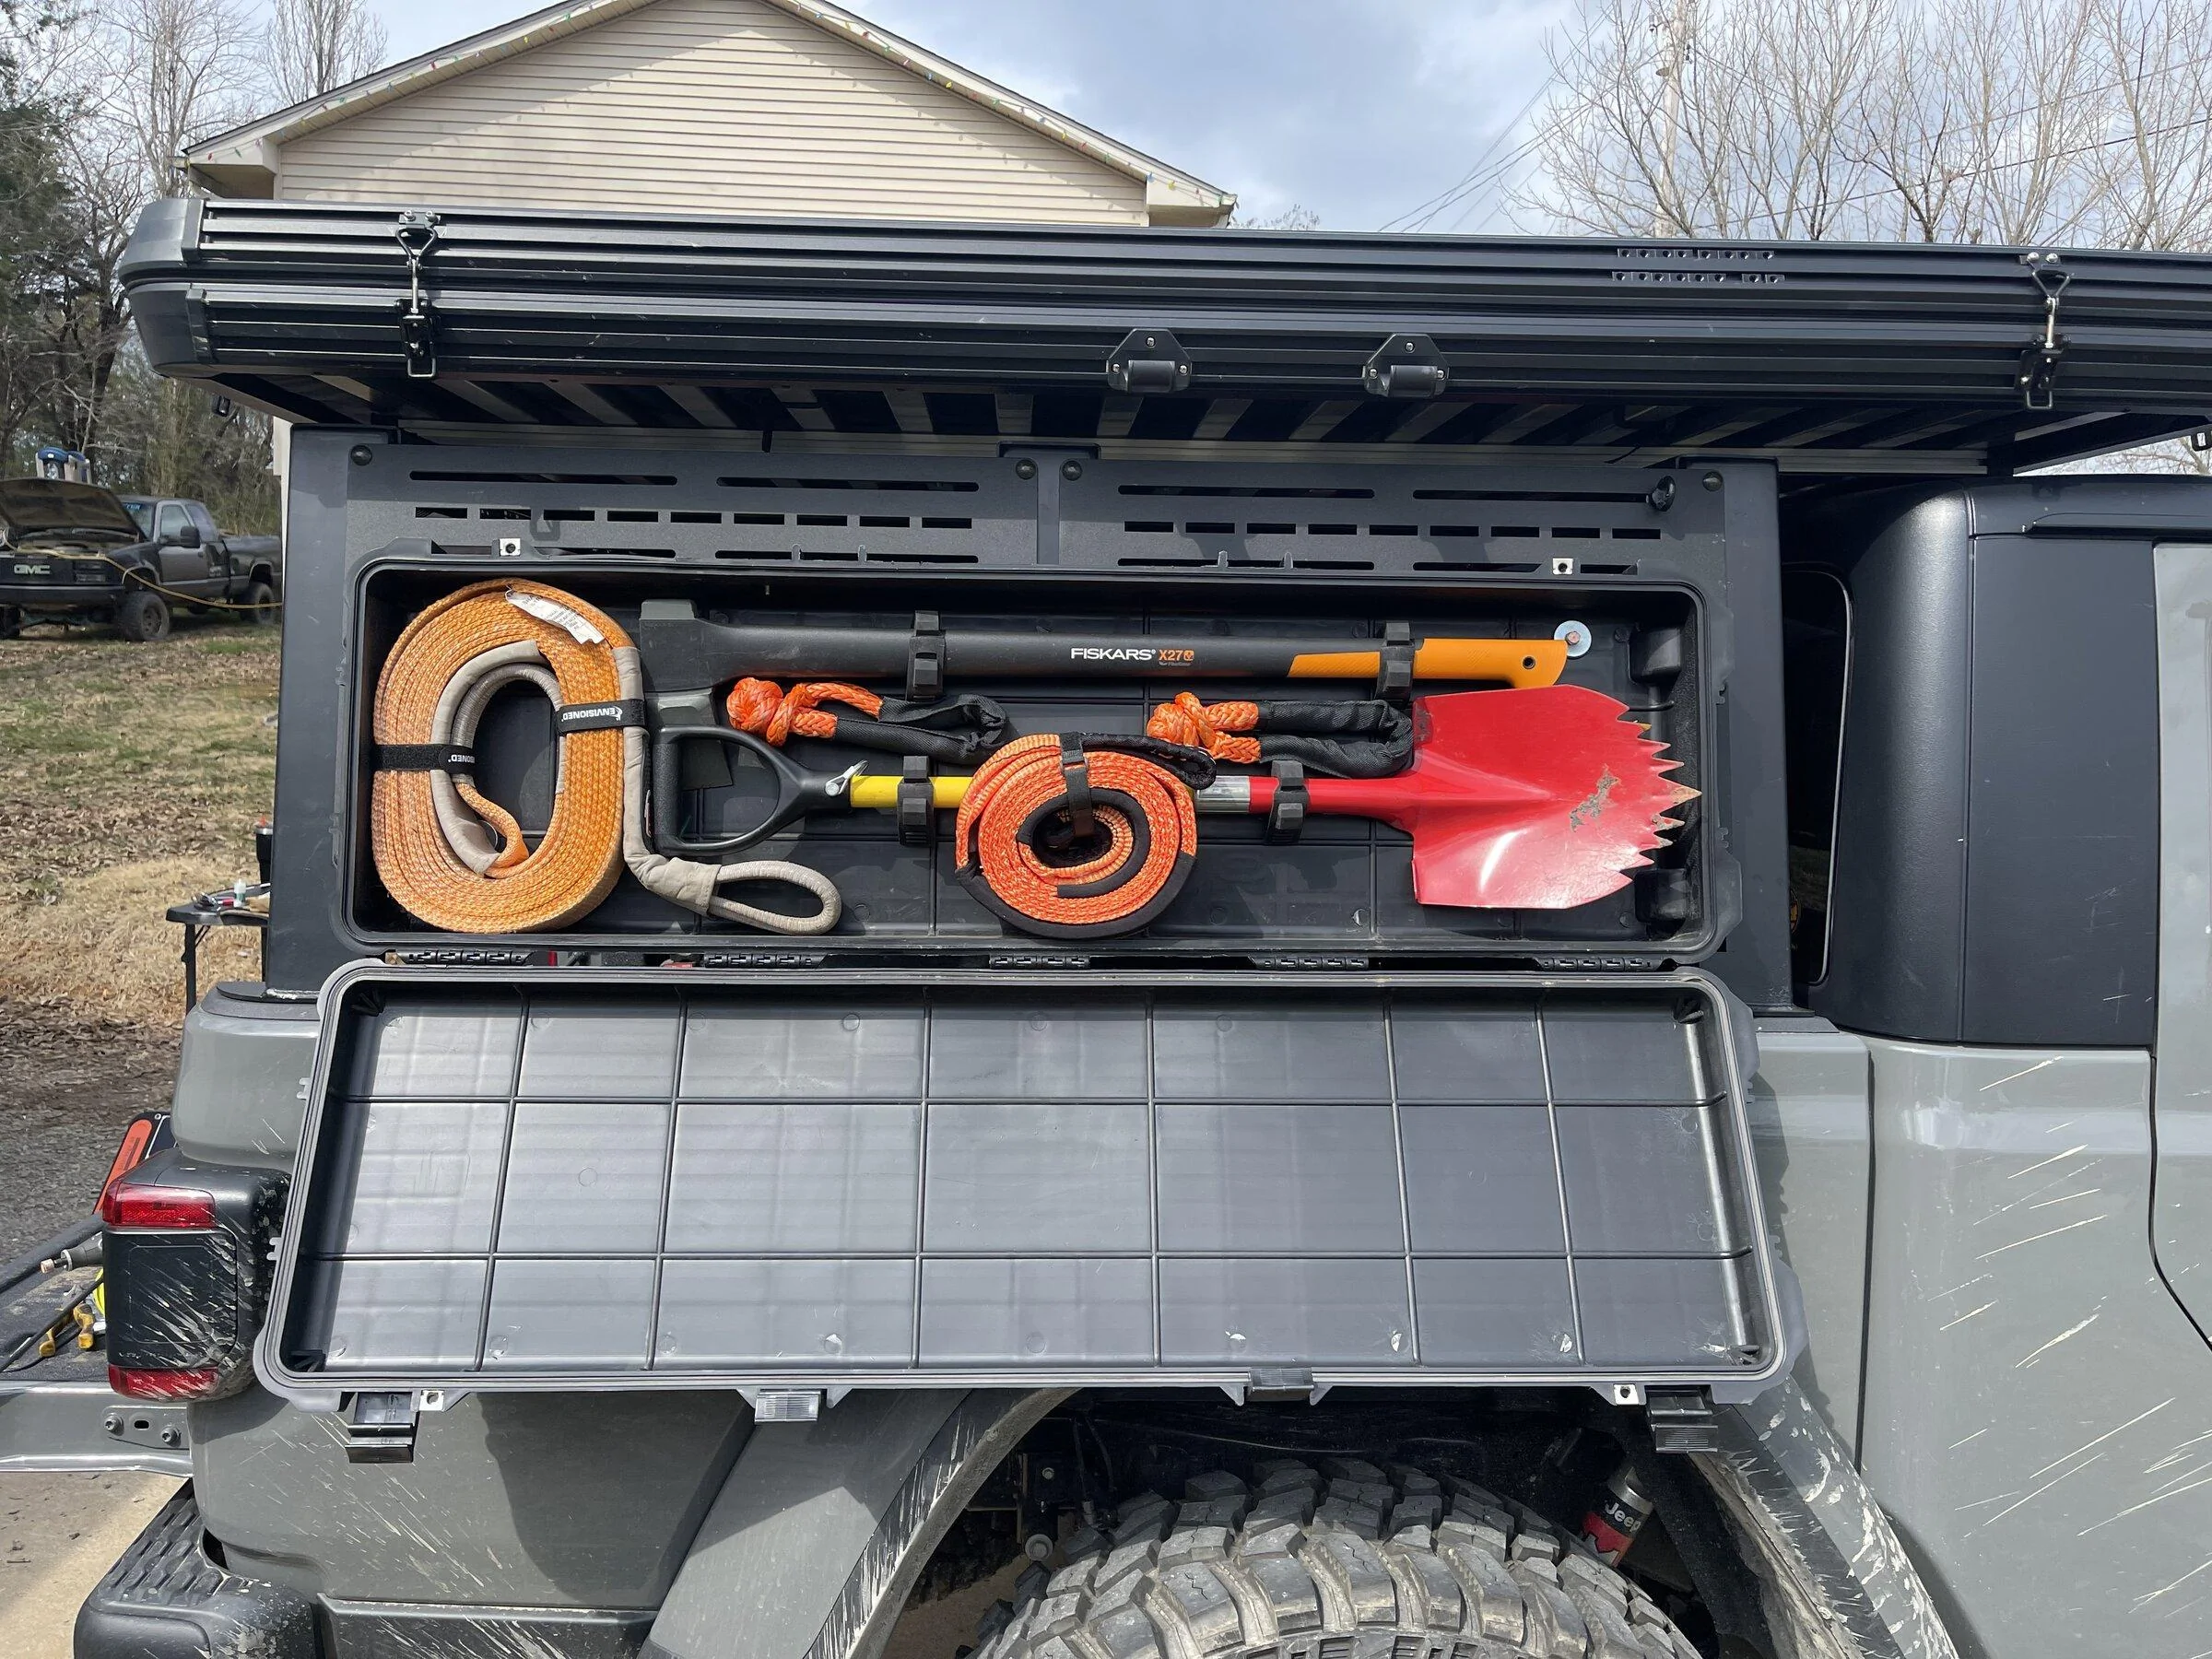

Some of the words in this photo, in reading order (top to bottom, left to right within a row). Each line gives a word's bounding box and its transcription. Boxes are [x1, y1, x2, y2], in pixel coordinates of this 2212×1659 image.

[14, 564, 51, 574] GMC
[1070, 648, 1153, 661] FISKARS
[1159, 649, 1183, 661] X27
[562, 707, 616, 721] ENVISIONED
[1605, 1502, 1641, 1533] Jeep
